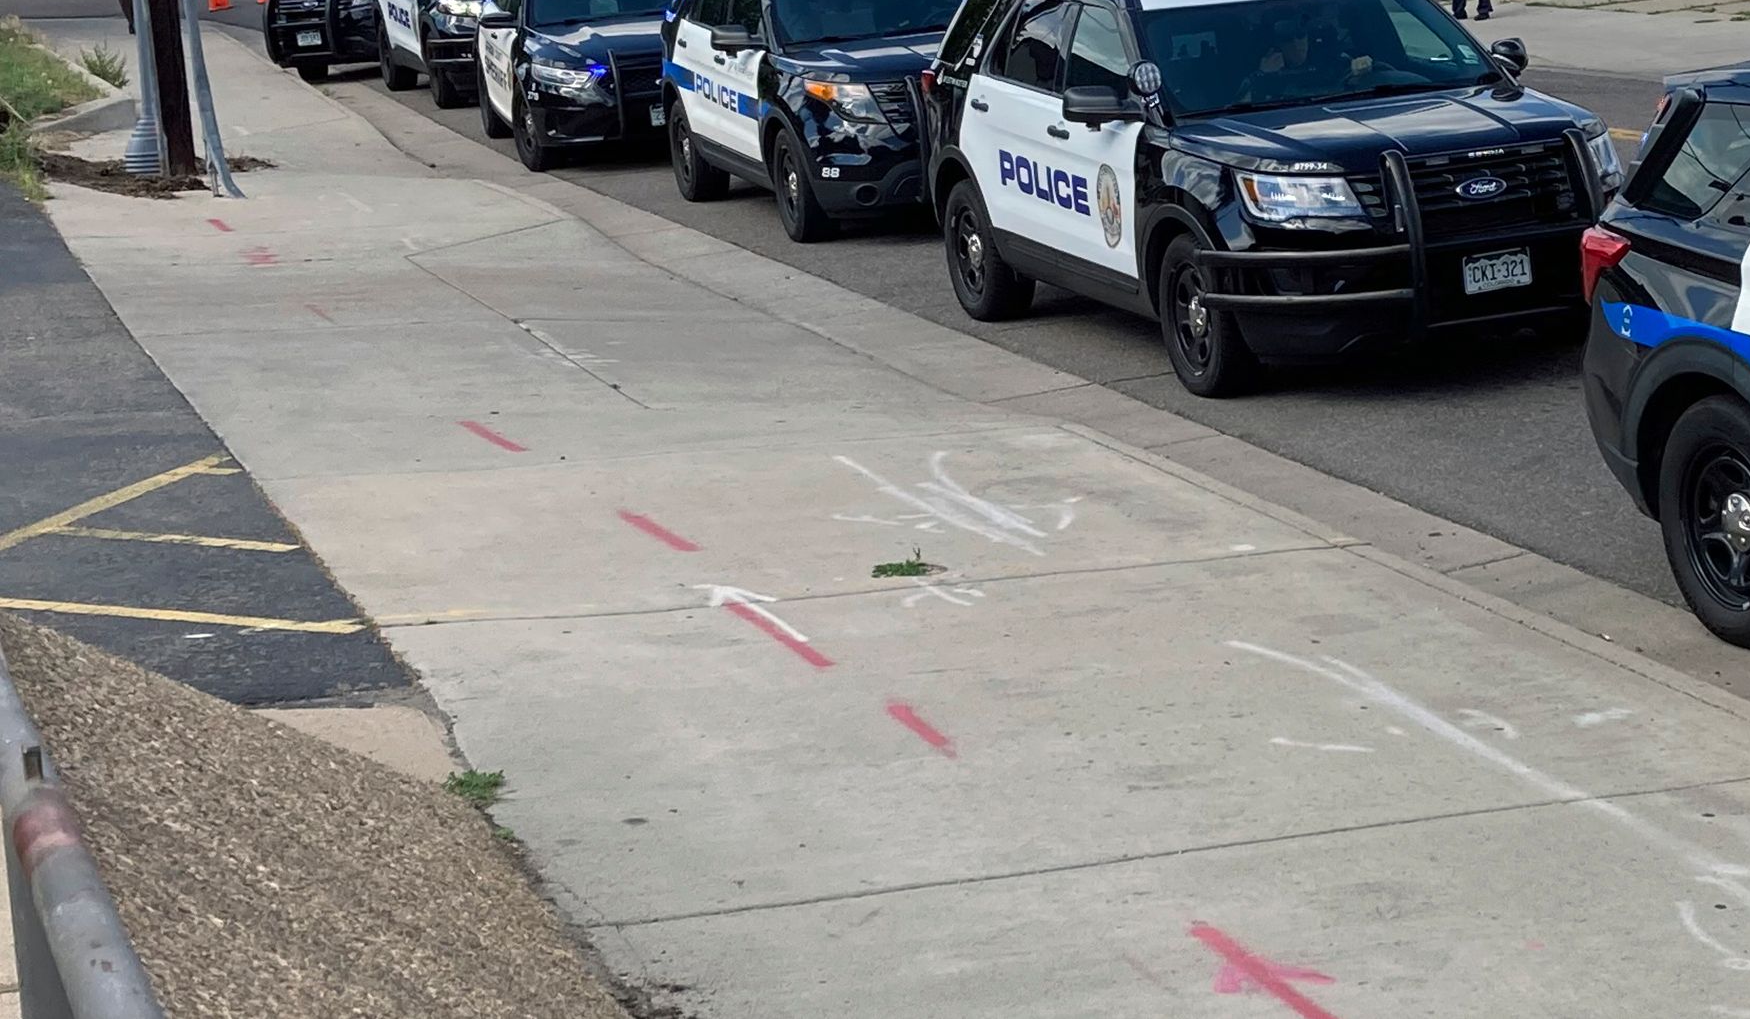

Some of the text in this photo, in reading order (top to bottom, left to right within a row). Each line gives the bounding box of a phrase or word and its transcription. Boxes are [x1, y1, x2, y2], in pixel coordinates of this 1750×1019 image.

[387, 1, 411, 29] POLICE
[694, 73, 738, 113] POLICE
[821, 168, 840, 178] 88
[998, 149, 1091, 217] POLICE
